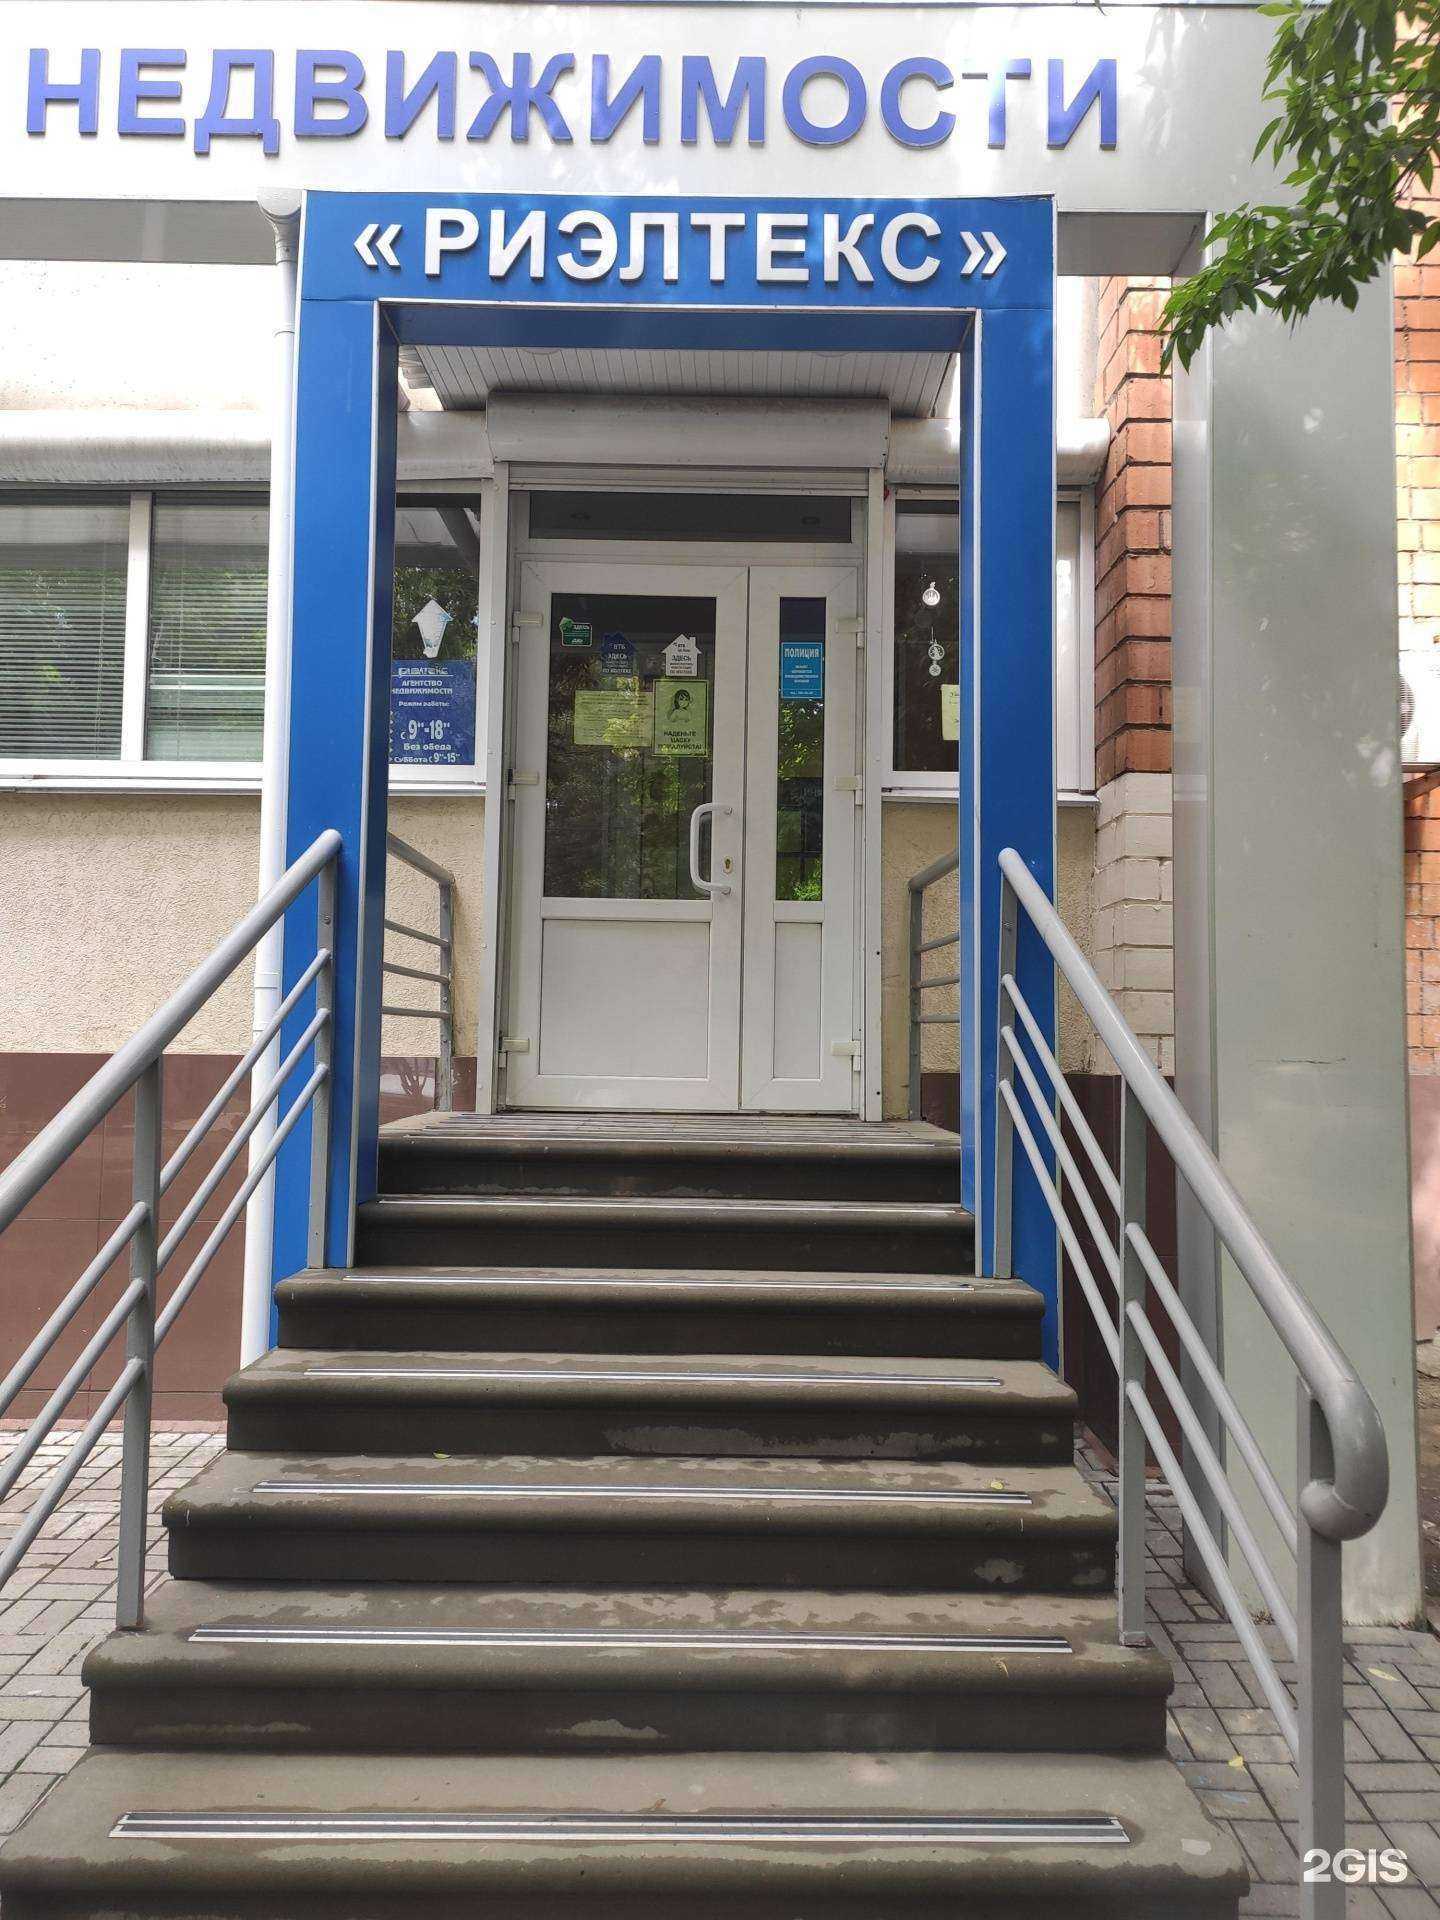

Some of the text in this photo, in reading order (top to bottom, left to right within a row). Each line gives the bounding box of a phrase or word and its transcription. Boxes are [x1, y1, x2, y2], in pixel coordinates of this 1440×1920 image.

[27, 48, 1118, 156] НЕДВИЖИМОСТИ
[353, 207, 1008, 284] «РИЭЛТЕКС»
[784, 648, 819, 659] ПОЛИЦИЯ
[403, 743, 421, 751] Без
